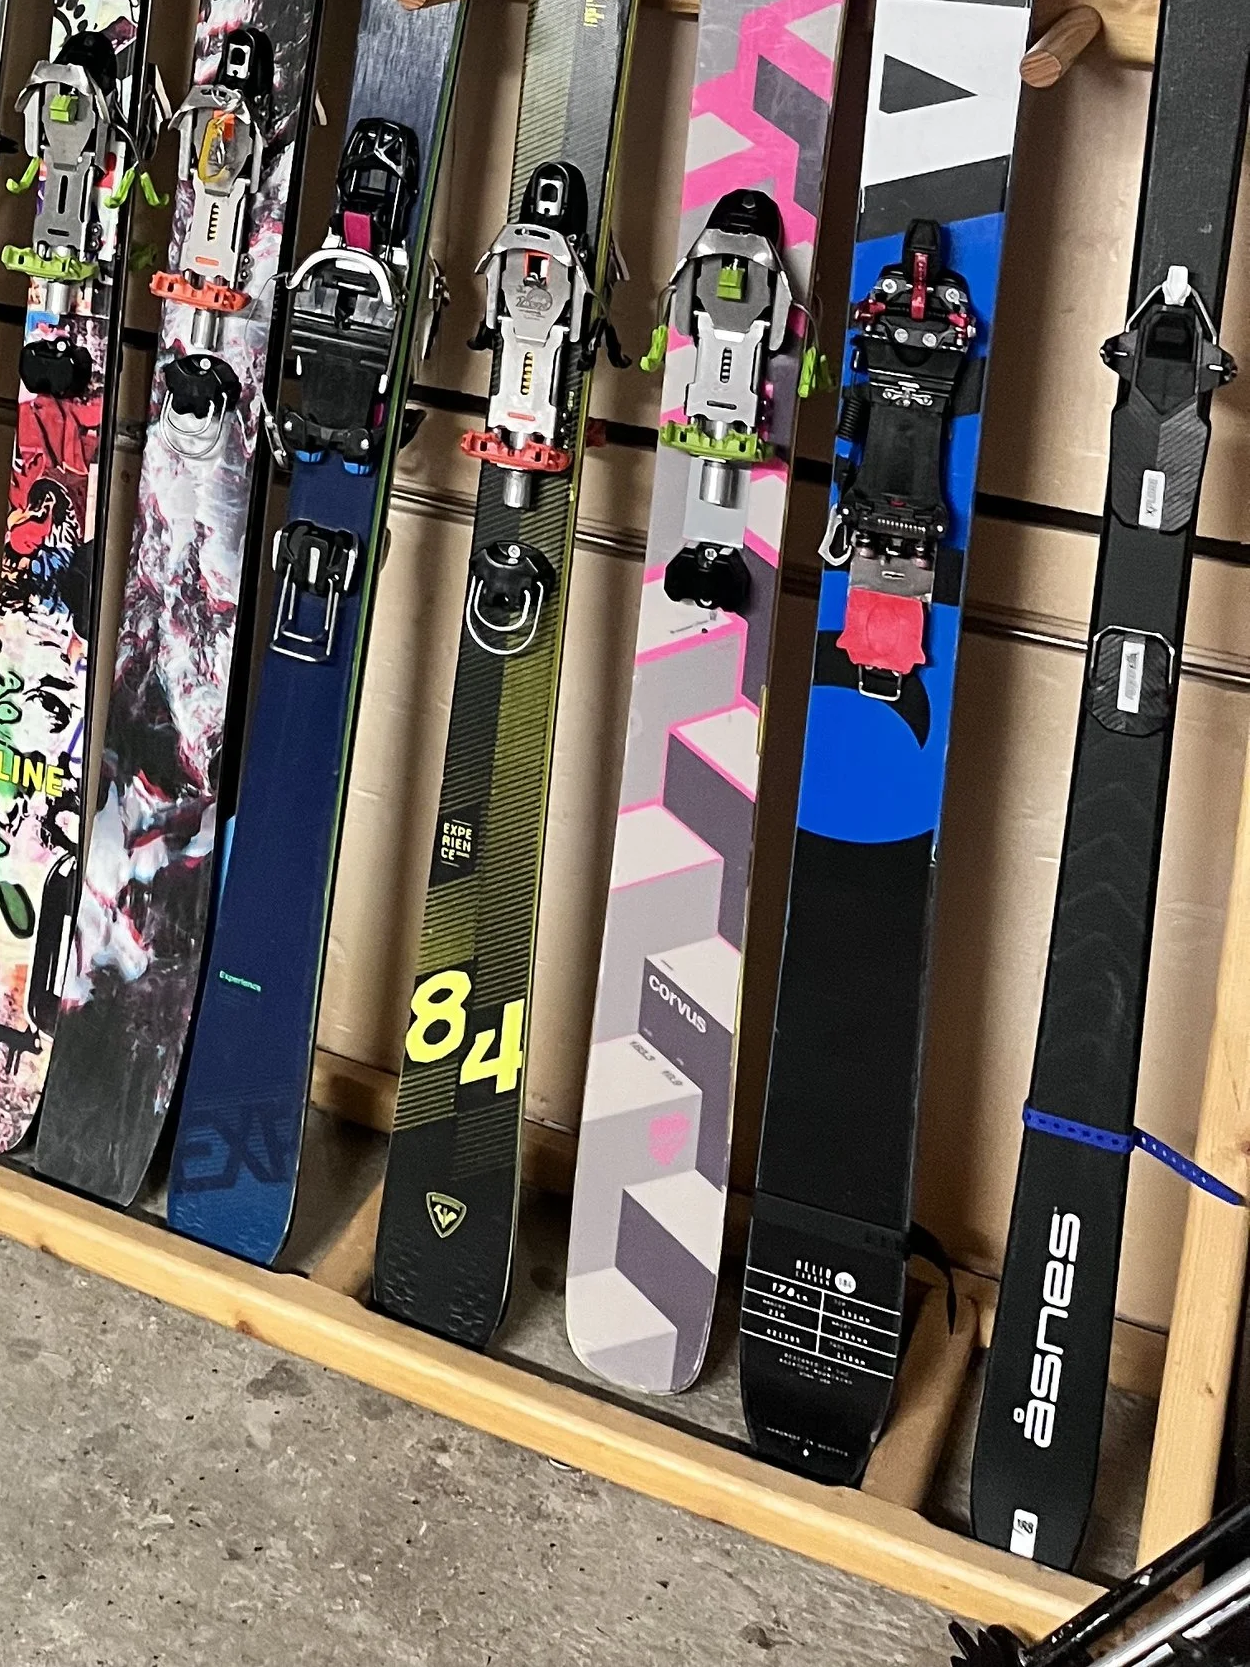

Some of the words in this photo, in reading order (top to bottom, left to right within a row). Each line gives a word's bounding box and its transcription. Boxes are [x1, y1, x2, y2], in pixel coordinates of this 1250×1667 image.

[441, 835, 472, 853] RIEN
[443, 822, 473, 841] EXPE
[405, 970, 526, 1094] 84
[648, 974, 707, 1034] corvus
[1013, 1211, 1081, 1449] åsnes
